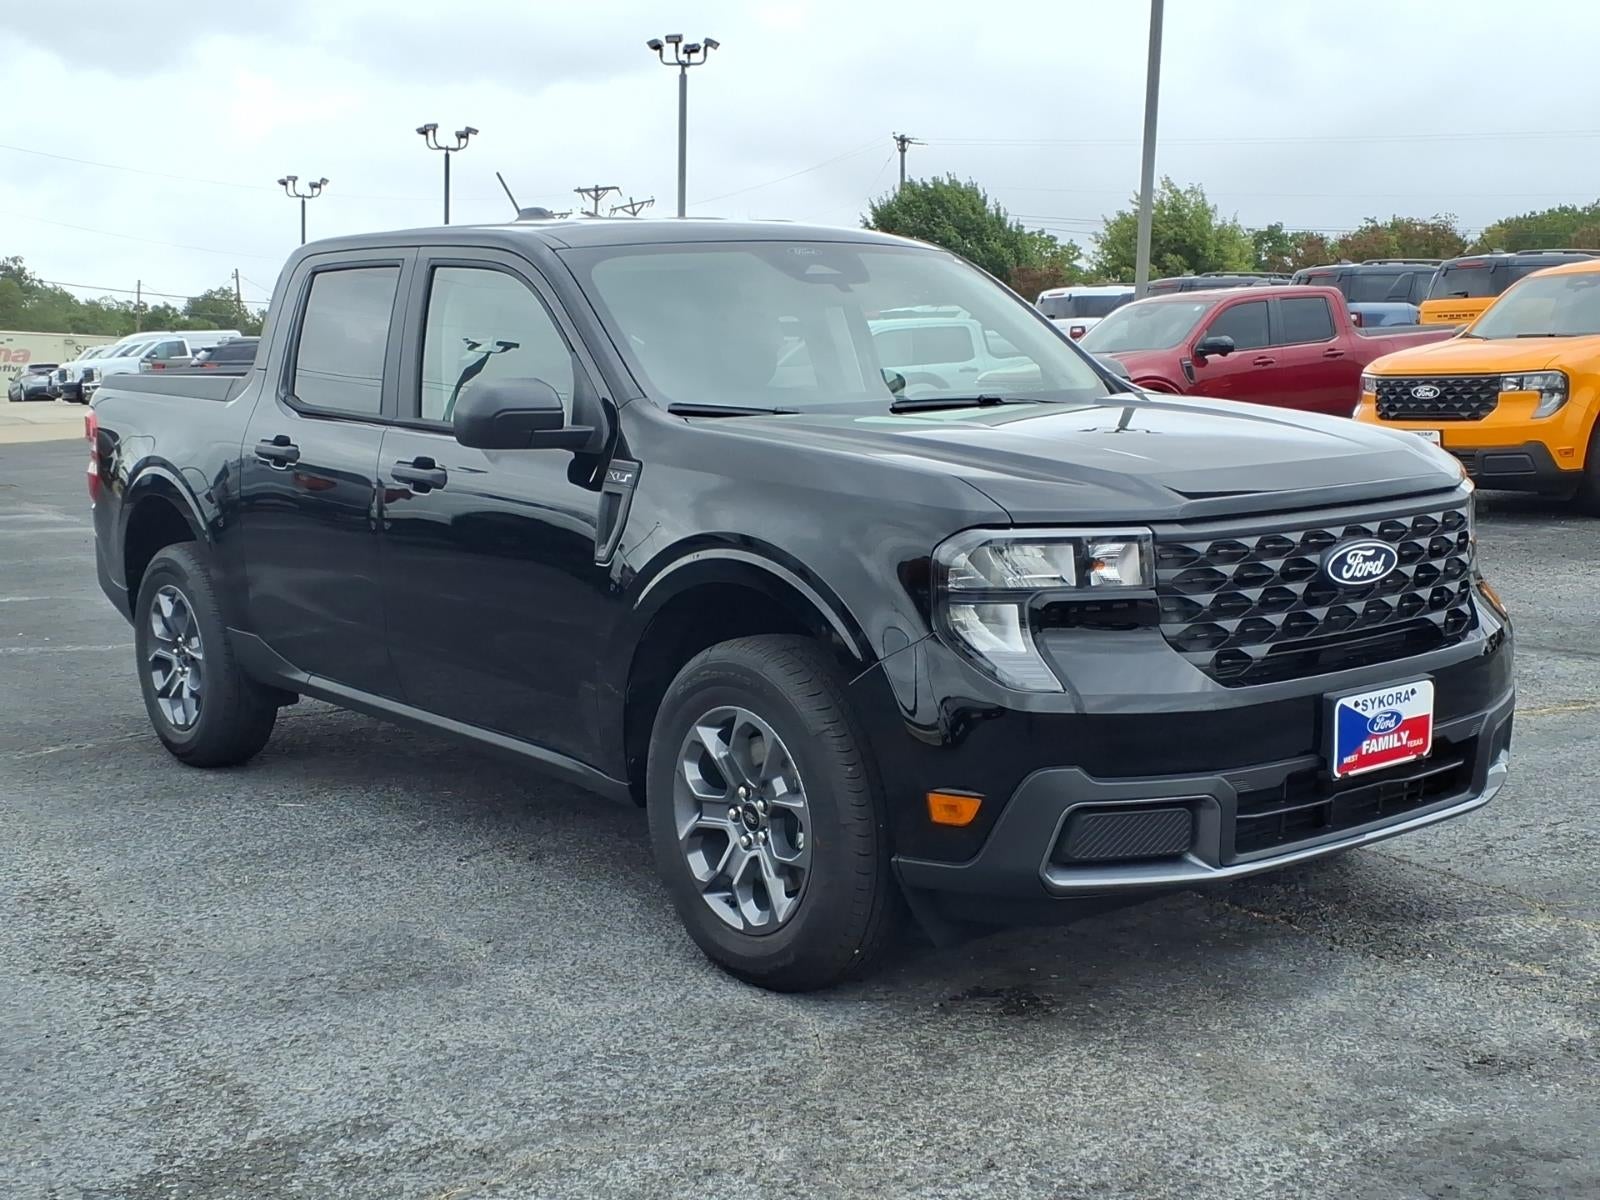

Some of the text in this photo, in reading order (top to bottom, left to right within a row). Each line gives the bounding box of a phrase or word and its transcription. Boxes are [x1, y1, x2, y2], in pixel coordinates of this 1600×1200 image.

[609, 471, 632, 483] XLT
[1342, 548, 1386, 579] Ford
[1361, 690, 1411, 712] SYKORA
[1372, 712, 1398, 732] Ford
[1361, 730, 1409, 755] FAMILY
[1407, 738, 1424, 748] TEXAS
[1343, 754, 1359, 764] WEST
